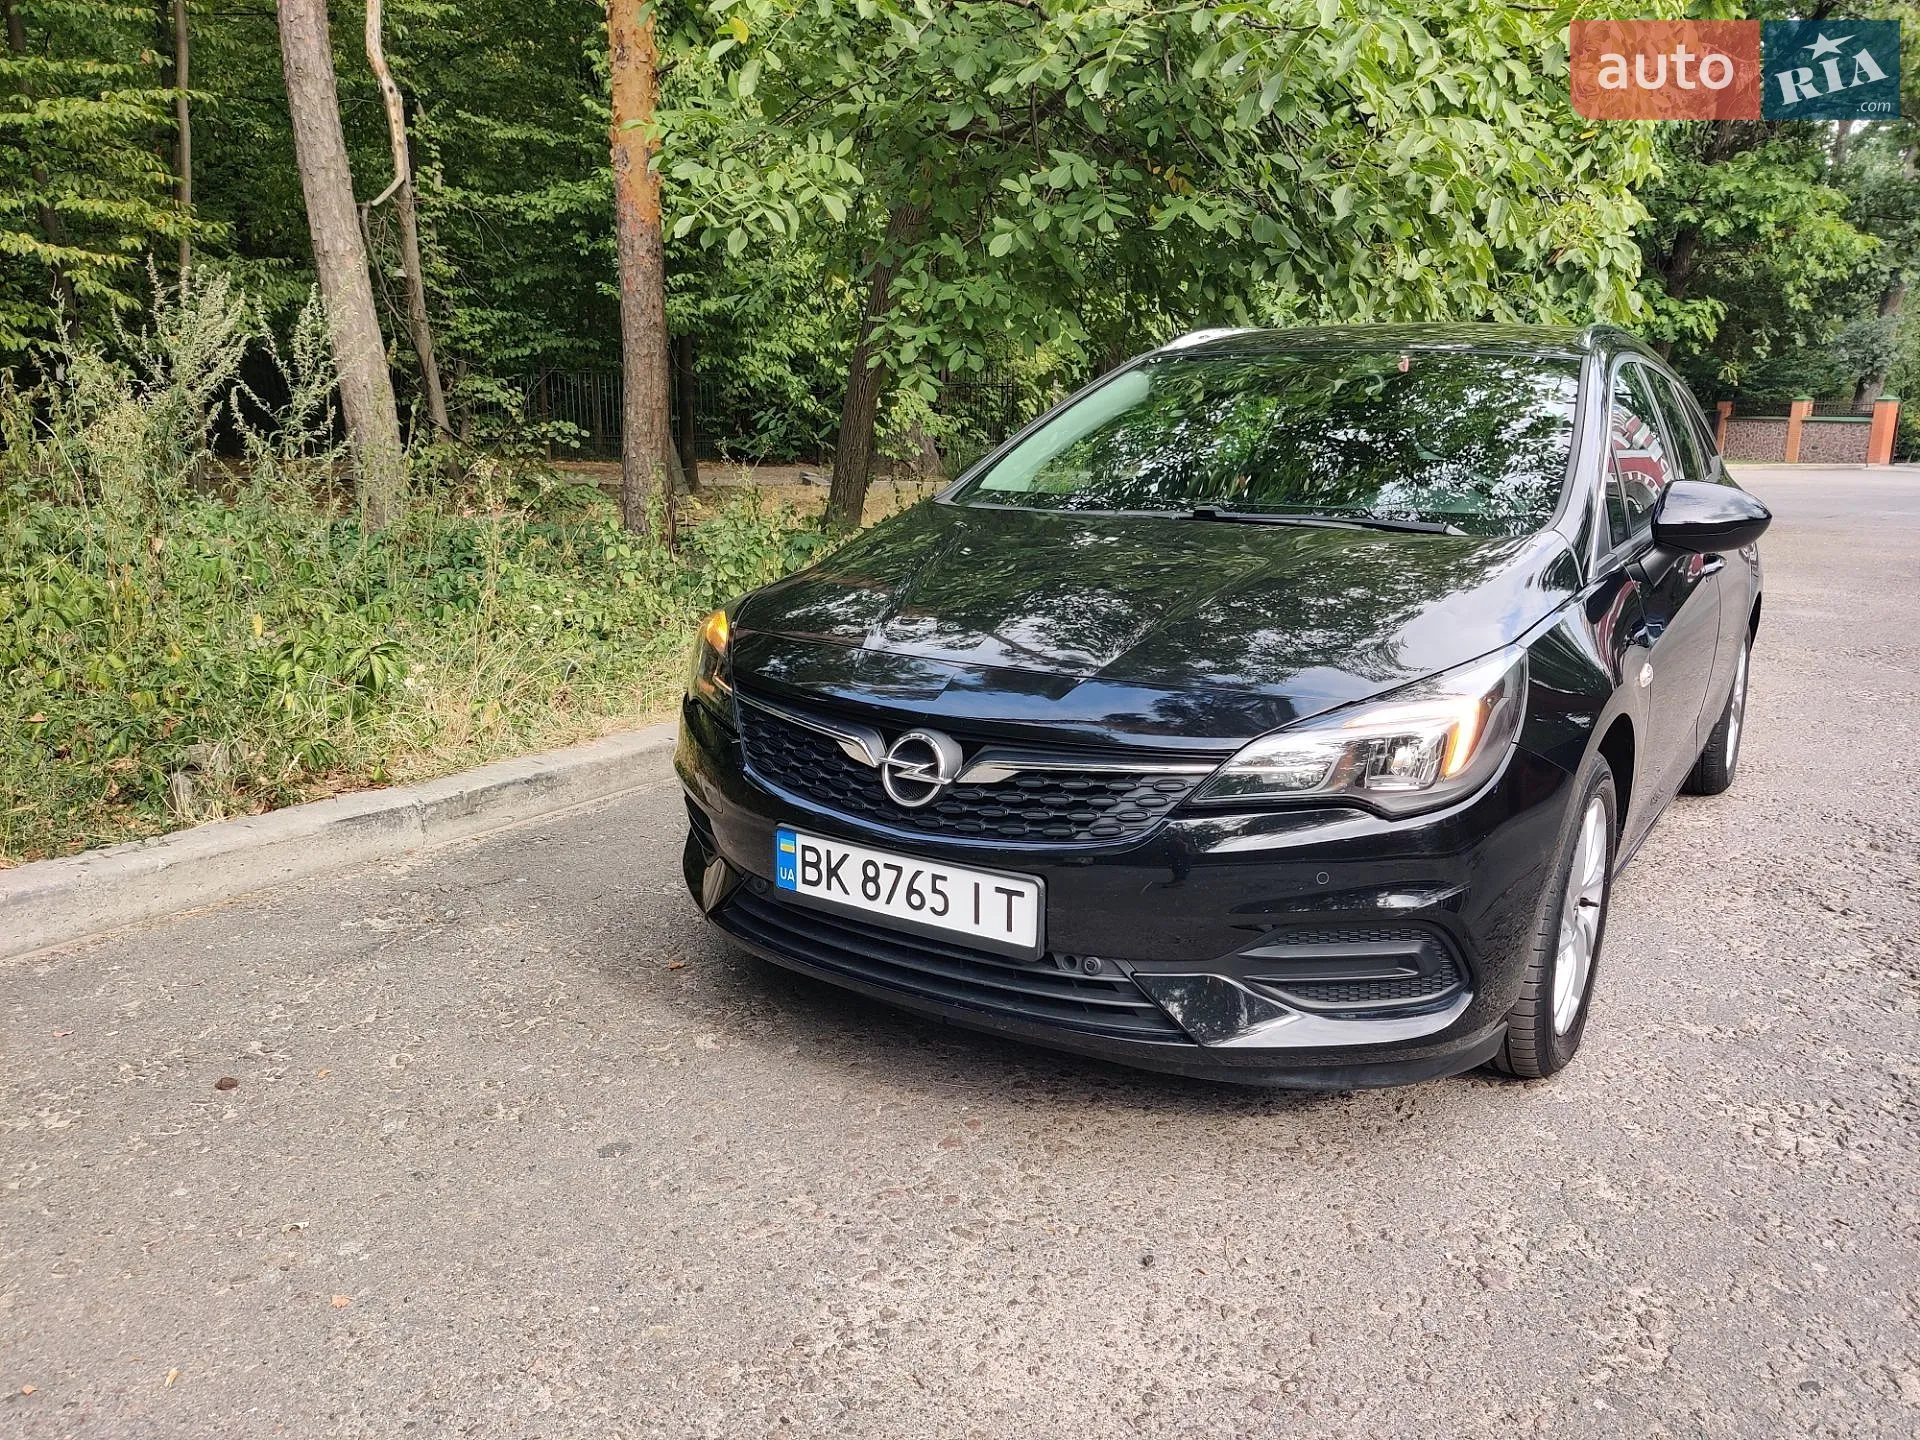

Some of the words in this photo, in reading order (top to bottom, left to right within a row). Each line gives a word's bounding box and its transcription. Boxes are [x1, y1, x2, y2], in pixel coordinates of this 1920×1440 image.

[780, 866, 795, 882] UA
[801, 844, 850, 896] BK
[861, 859, 950, 916] 8765
[973, 882, 1025, 932] IT
